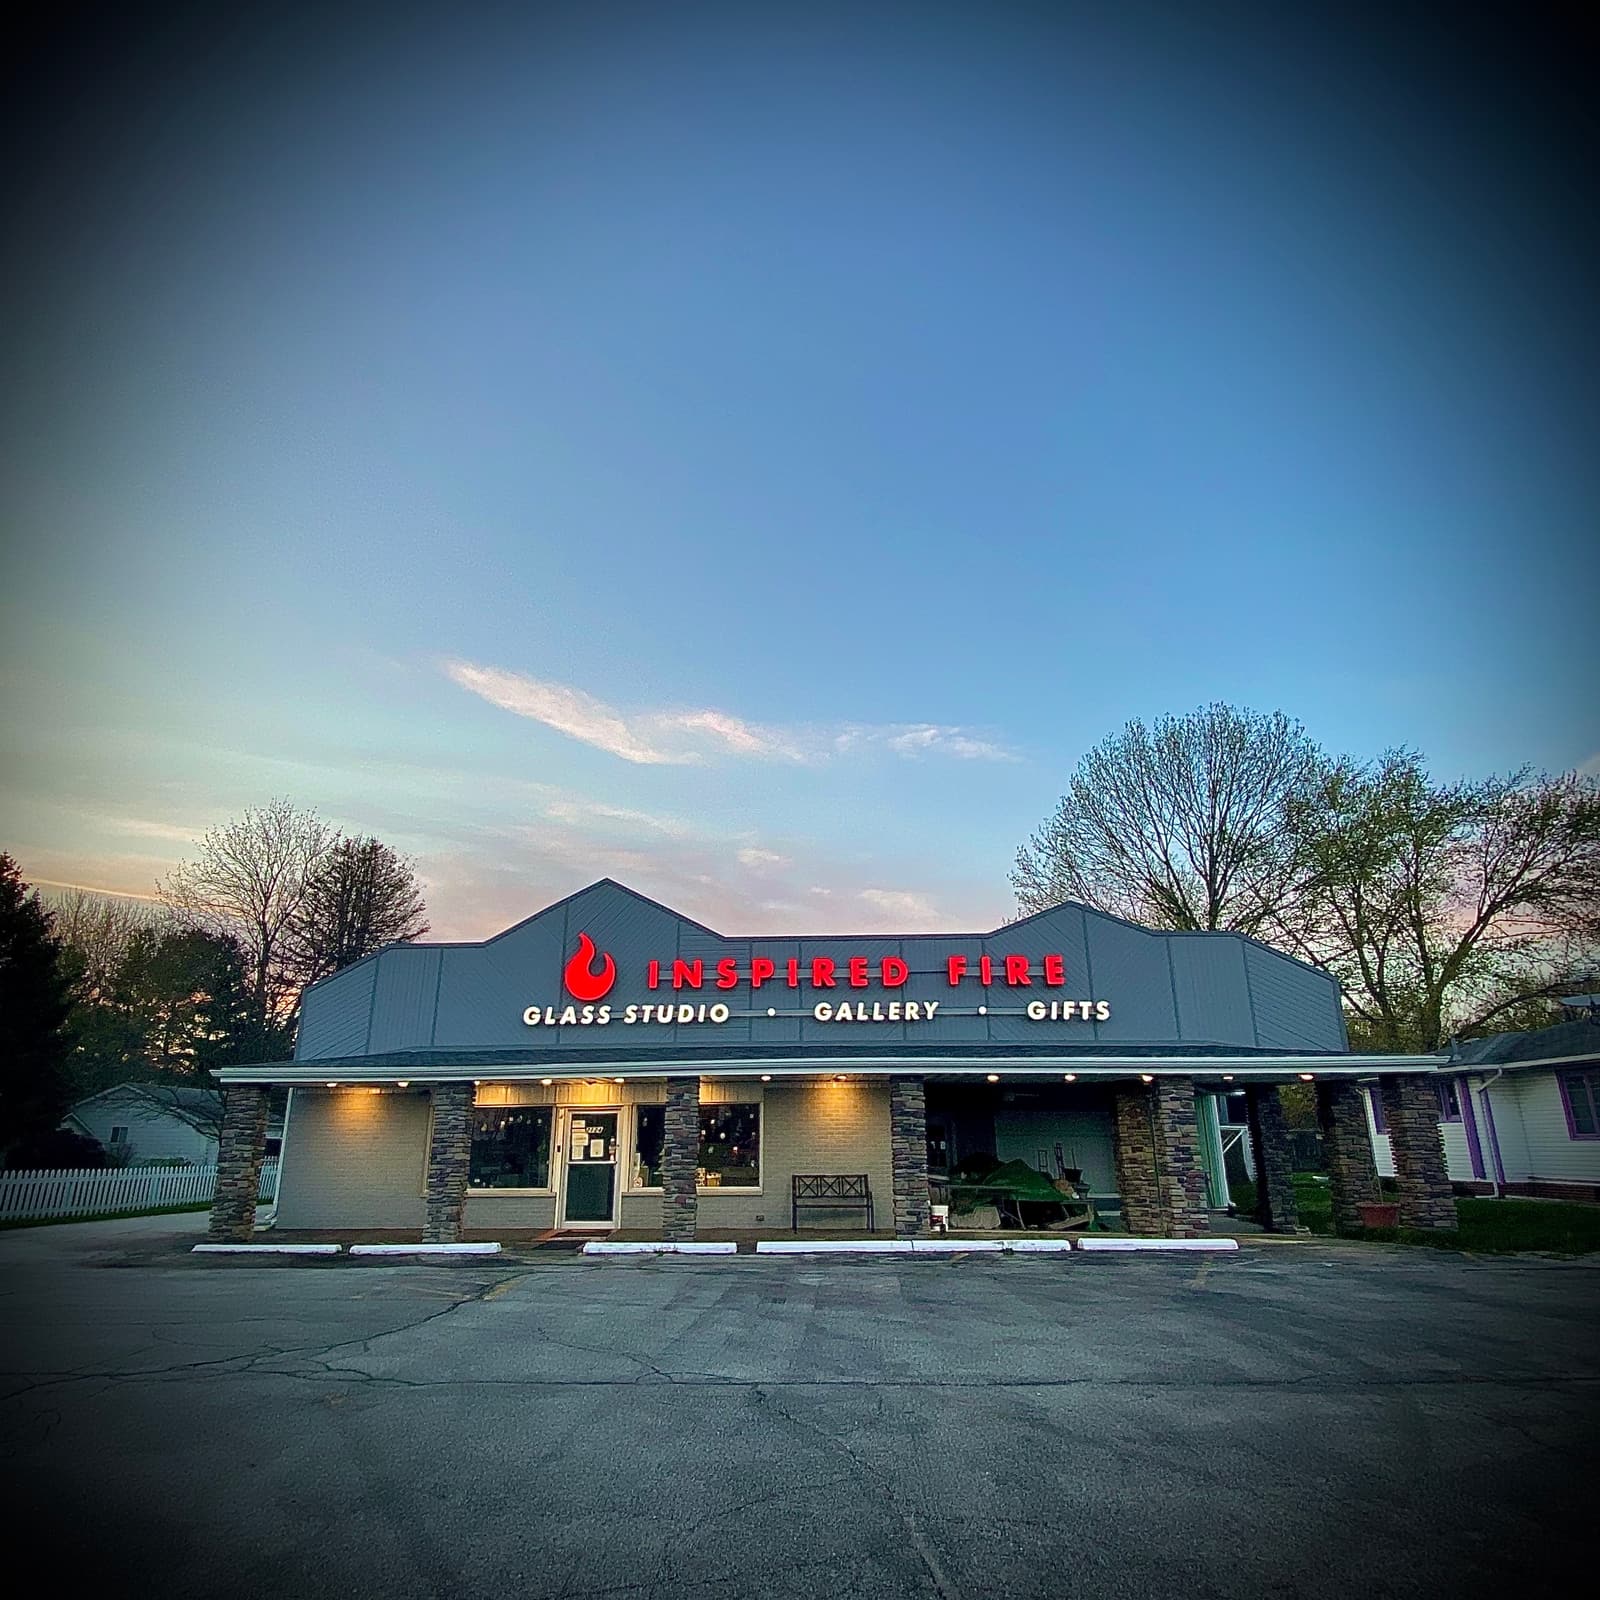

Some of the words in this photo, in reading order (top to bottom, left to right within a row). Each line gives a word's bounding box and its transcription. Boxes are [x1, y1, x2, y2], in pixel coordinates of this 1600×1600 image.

[646, 956, 910, 989] INSPIRED
[947, 954, 1066, 986] FIRE
[523, 1005, 612, 1025] GLASS
[623, 1003, 729, 1024] STUDIO
[813, 1001, 939, 1021] GALLERY
[1027, 1000, 1111, 1021] GIFTS
